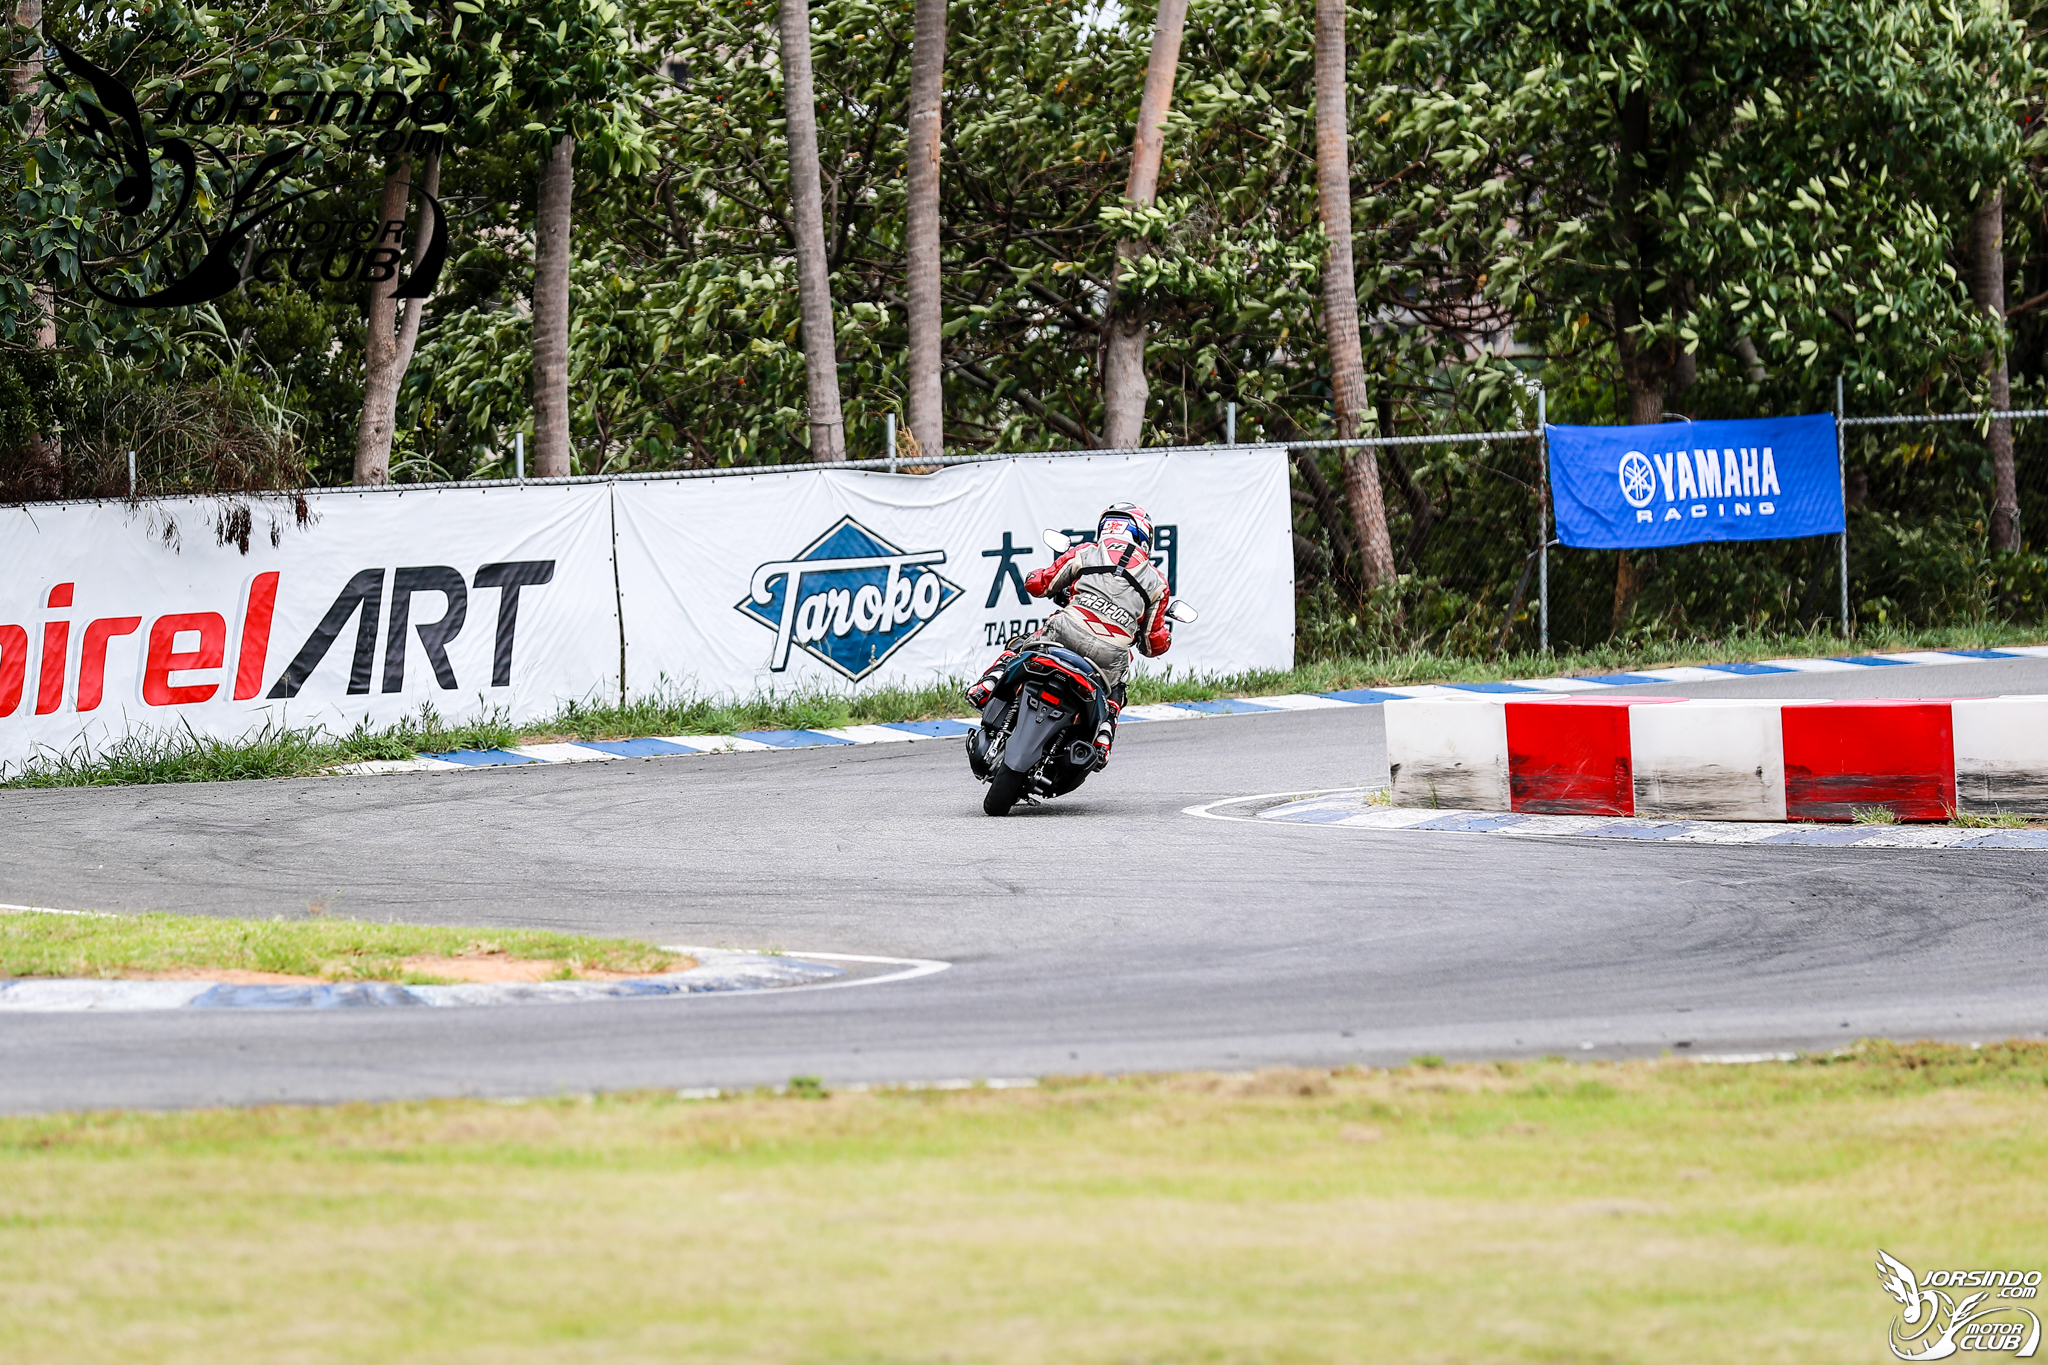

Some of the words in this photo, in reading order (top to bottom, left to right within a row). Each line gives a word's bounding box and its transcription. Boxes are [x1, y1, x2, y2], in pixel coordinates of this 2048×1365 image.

[1653, 447, 1781, 502] YAMAHA
[1636, 502, 1775, 523] RACING
[750, 549, 946, 672] Taroko
[1079, 593, 1134, 627] PREXPORT
